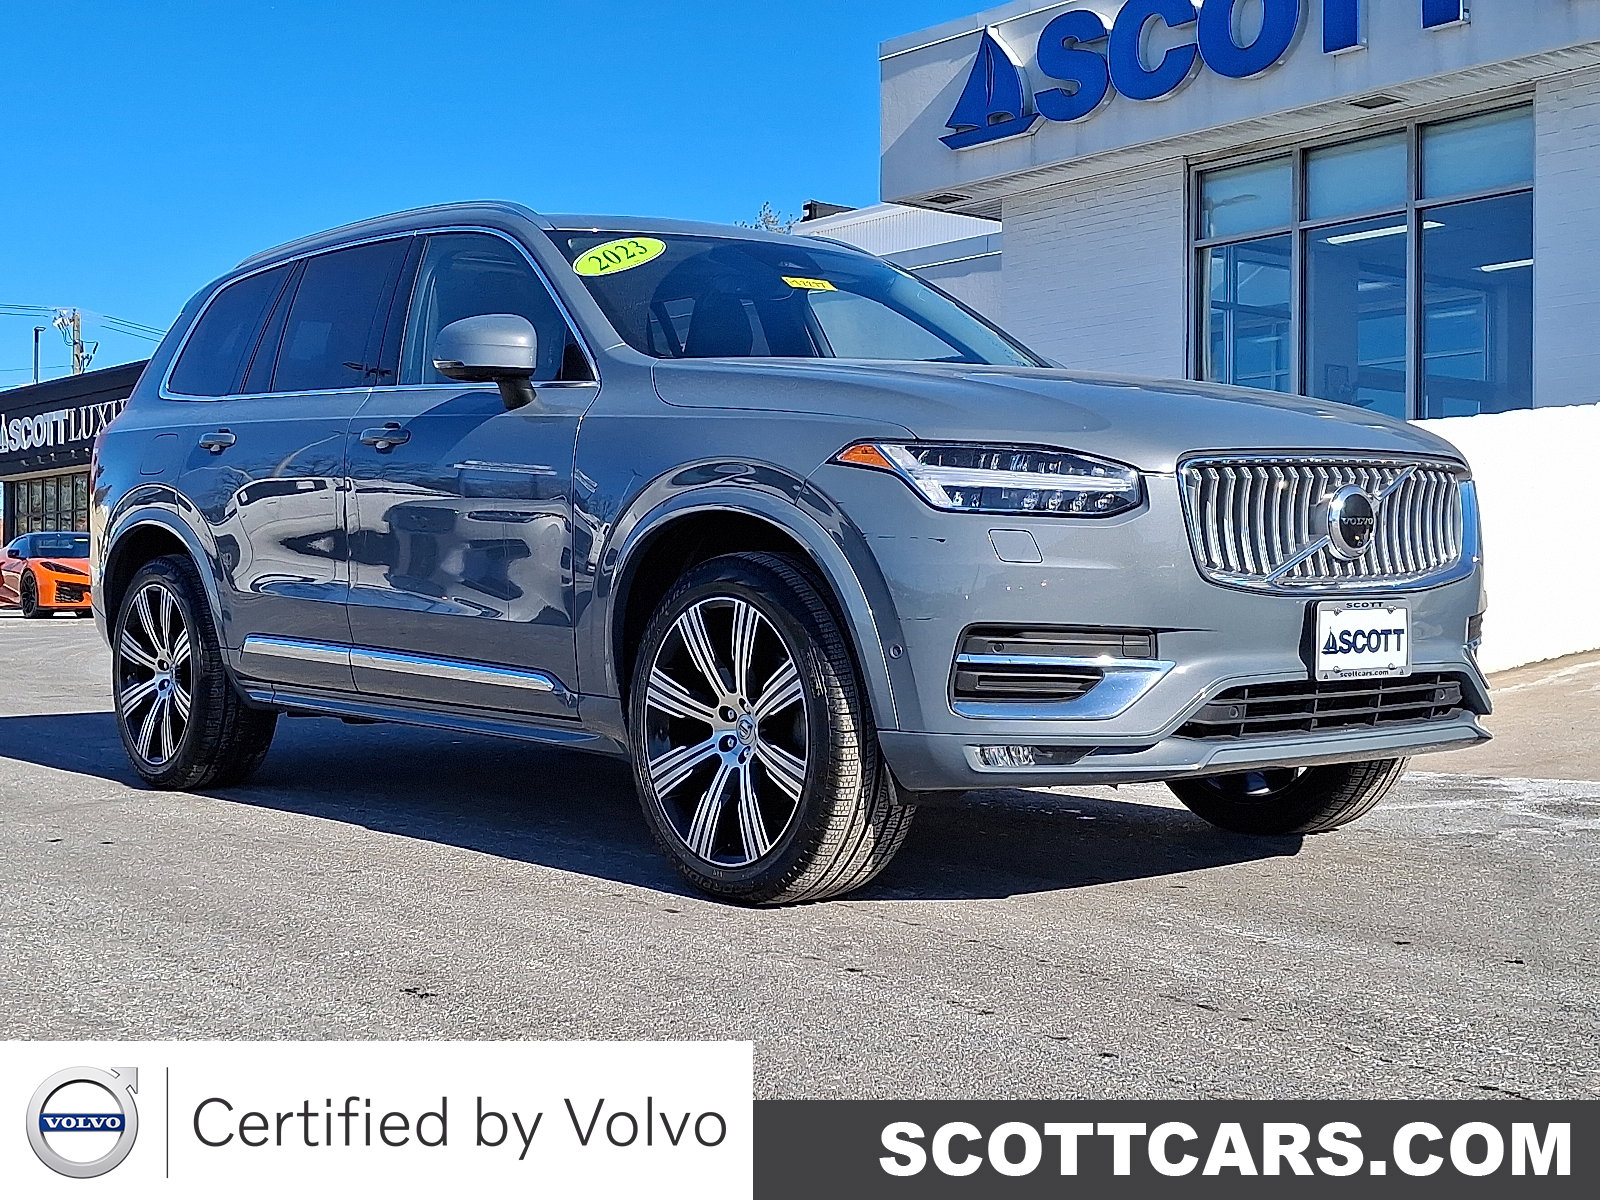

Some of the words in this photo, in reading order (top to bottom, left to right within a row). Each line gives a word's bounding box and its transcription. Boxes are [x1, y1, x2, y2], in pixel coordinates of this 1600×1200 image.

[589, 241, 648, 271] 2023
[9, 408, 69, 452] SCOTT
[1339, 628, 1405, 654] SCOTT
[1340, 670, 1389, 678] scottcars.com
